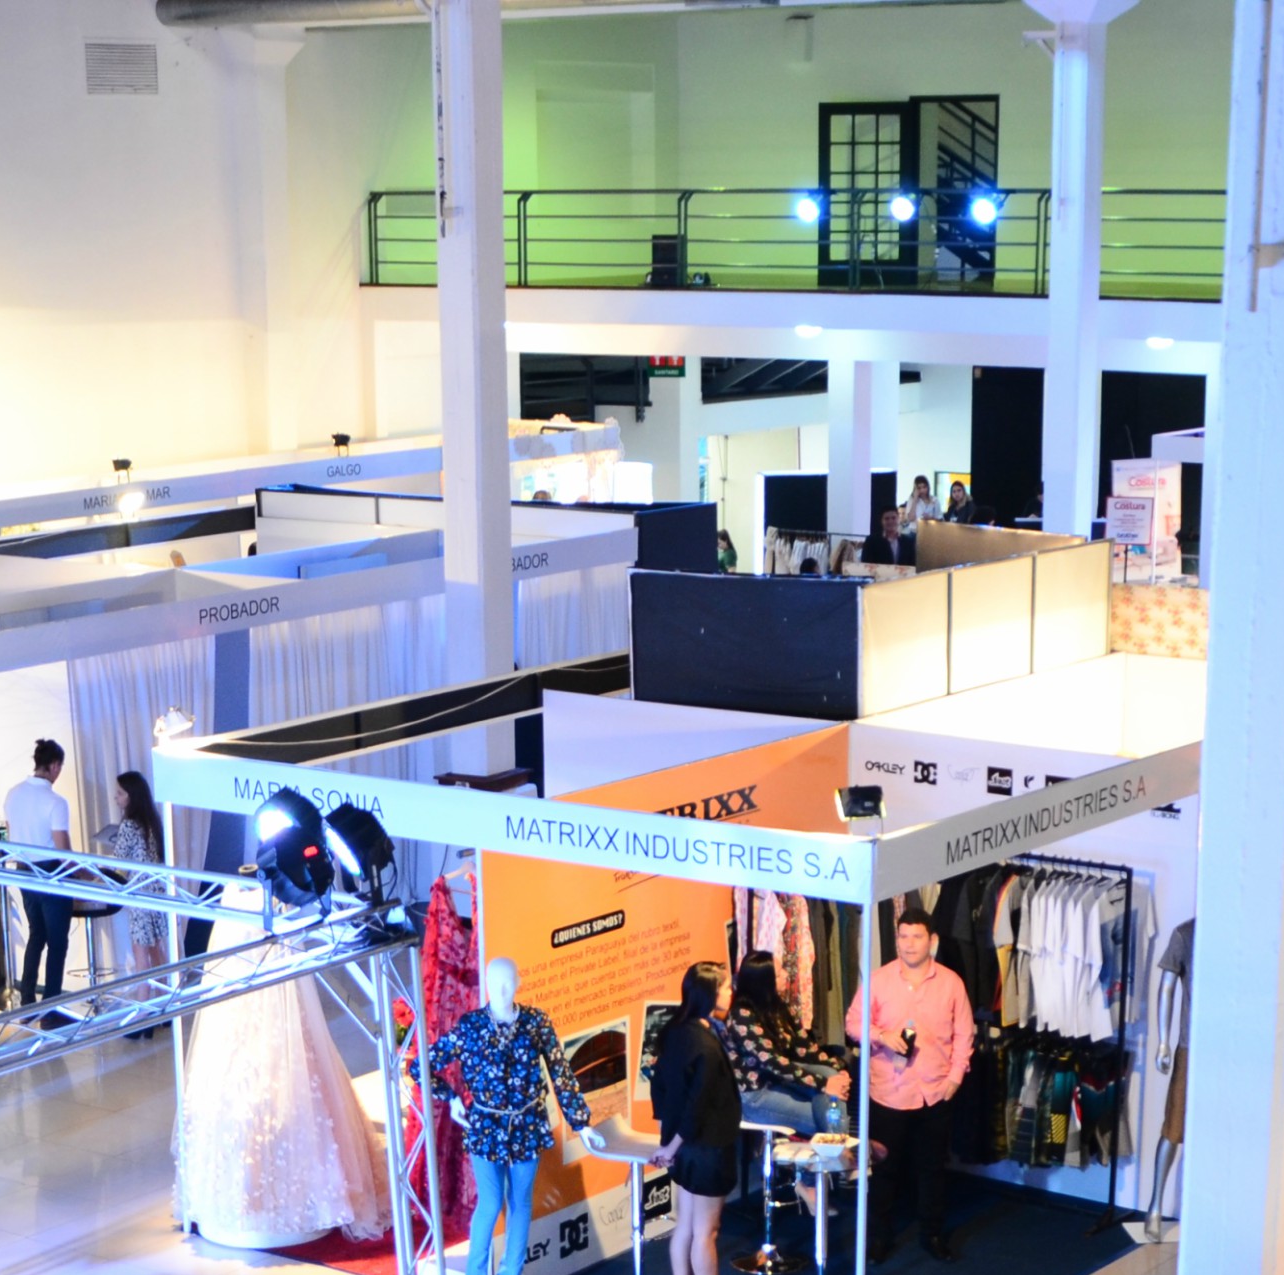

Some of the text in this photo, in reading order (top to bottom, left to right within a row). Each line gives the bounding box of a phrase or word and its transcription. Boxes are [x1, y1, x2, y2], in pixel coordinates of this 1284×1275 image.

[326, 463, 362, 478] GALGO
[198, 596, 281, 626] PROBADOR
[864, 760, 906, 776] OAKLEY
[945, 774, 1147, 867] MATRIXX INDUSTRIES S.A
[505, 814, 850, 883] MATRIXX INDUSTRIES S.A
[553, 913, 623, 944] ¿QUIENES SOMOS?
